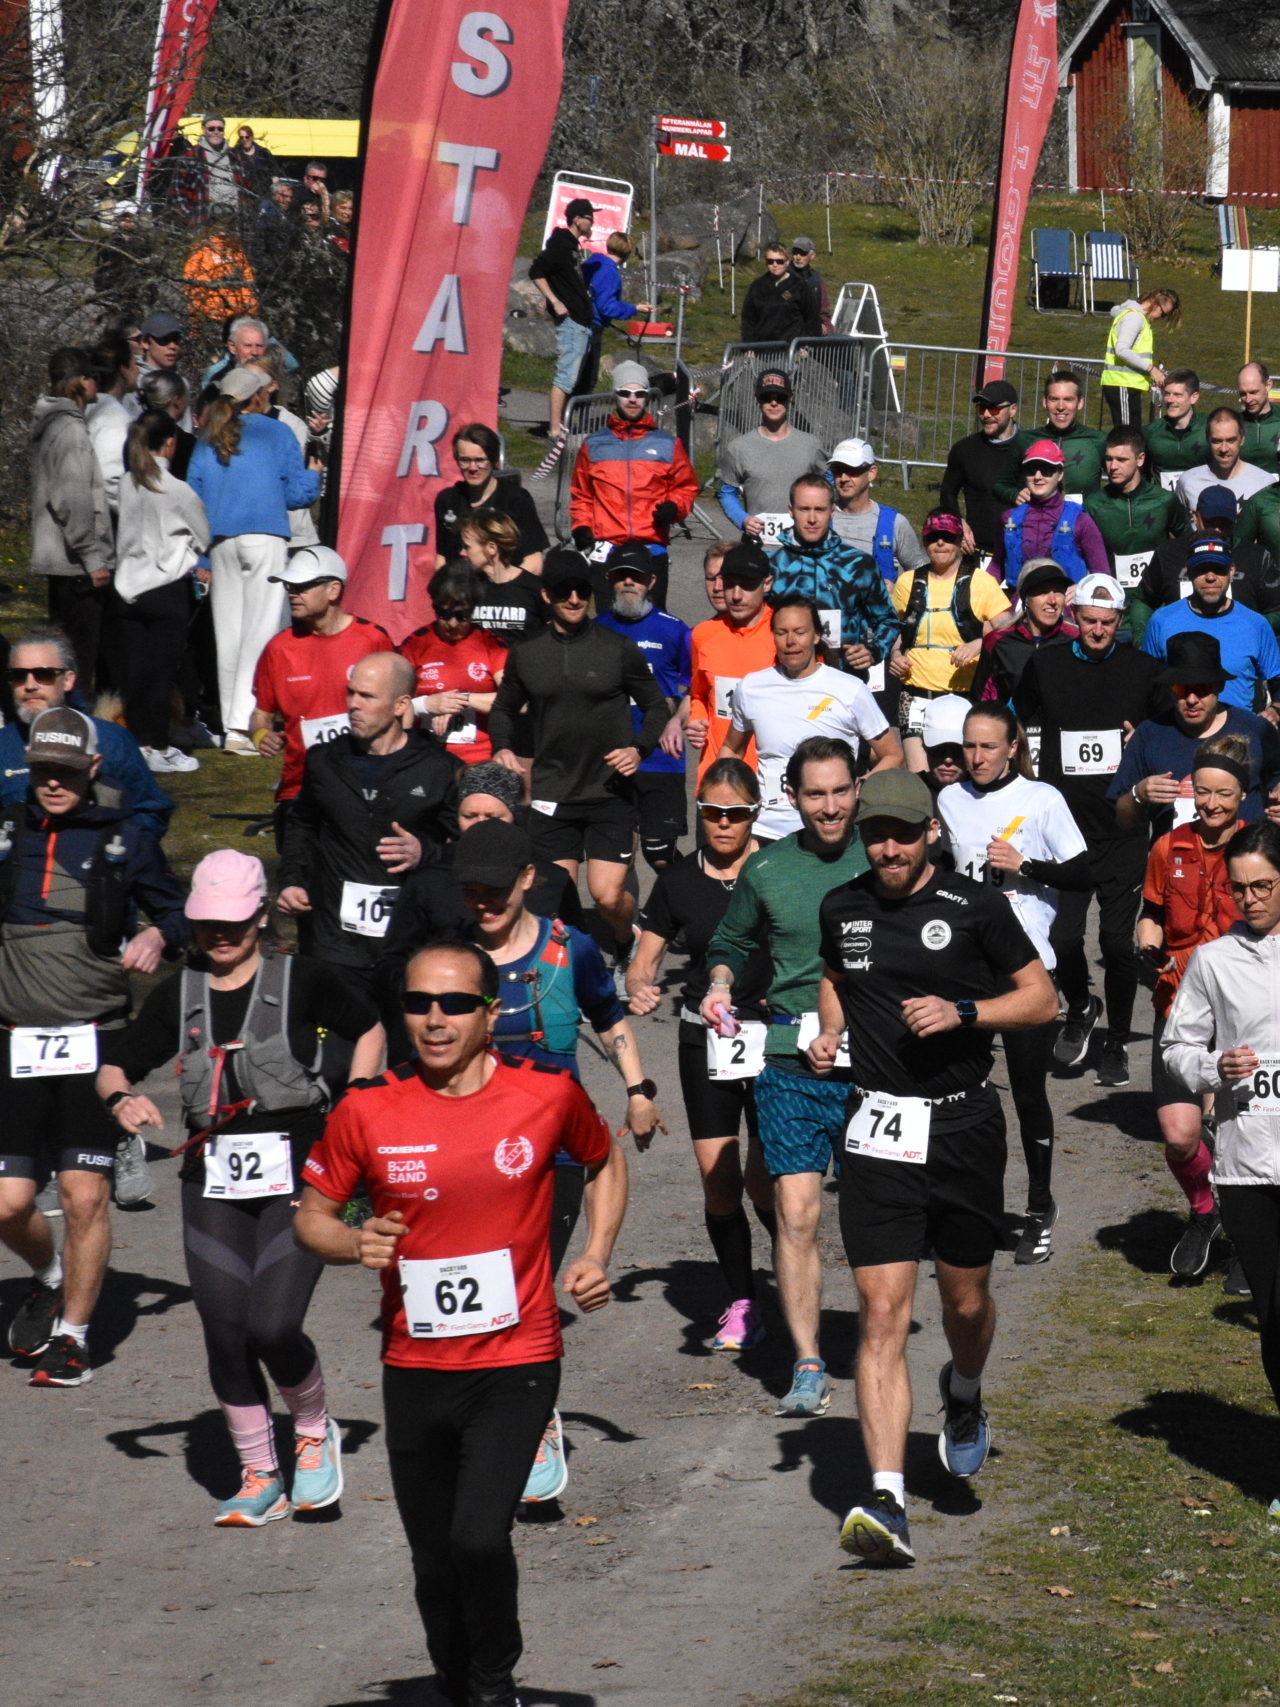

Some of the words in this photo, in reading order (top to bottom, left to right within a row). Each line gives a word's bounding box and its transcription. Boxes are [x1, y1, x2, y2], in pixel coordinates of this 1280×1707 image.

[661, 118, 713, 129] EFTERANMÄLAN
[661, 125, 713, 136] NUMMERLAPPAR
[675, 141, 708, 159] MÅL
[380, 11, 513, 601] START
[472, 605, 526, 621] ACKYARD
[35, 732, 82, 747] FUSION
[1079, 743, 1103, 763] 69
[965, 861, 1005, 888] 119
[936, 889, 963, 903] CRAFT
[36, 1034, 70, 1060] 72
[730, 1039, 746, 1064] 2
[946, 1091, 966, 1103] TYR
[870, 1108, 903, 1142] 74
[377, 1144, 438, 1154] COMENIUS
[228, 1152, 263, 1181] 92
[388, 1171, 427, 1184] SAND
[435, 1277, 483, 1316] 62
[468, 1322, 488, 1330] Camp
[490, 1313, 513, 1326] ADT
